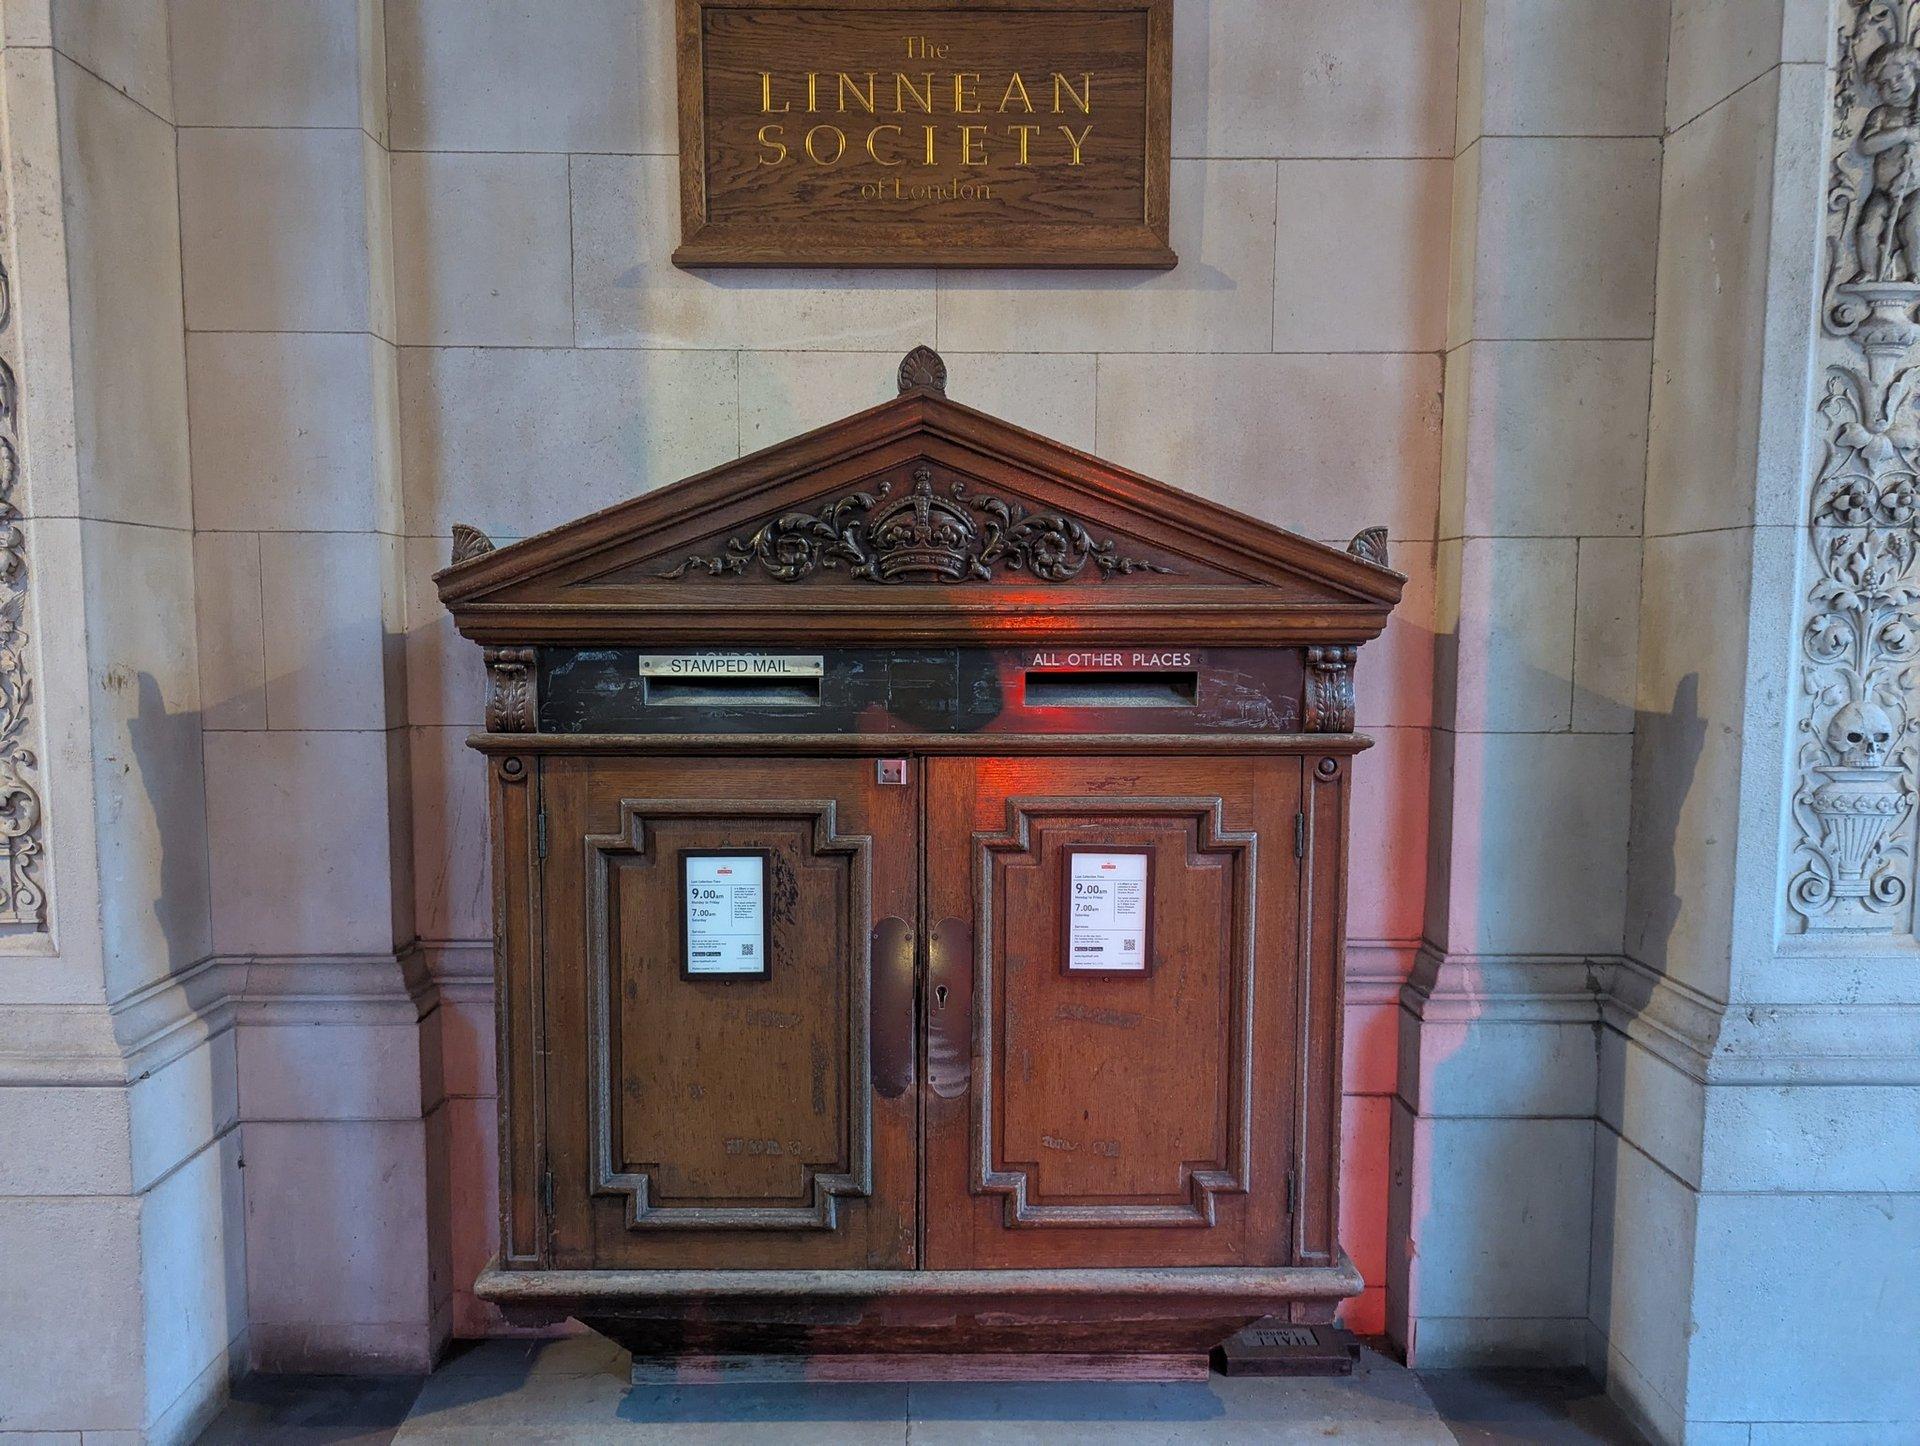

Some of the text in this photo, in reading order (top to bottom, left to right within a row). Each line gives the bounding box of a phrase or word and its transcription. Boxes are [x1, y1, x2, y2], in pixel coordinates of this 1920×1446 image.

[902, 36, 949, 60] The
[757, 71, 1094, 115] LINNEAN
[757, 124, 1094, 167] SOCIETY
[861, 177, 992, 201] of London
[670, 659, 791, 674] STAMPED MAIL
[1032, 653, 1192, 667] ALL OTHER PLACES
